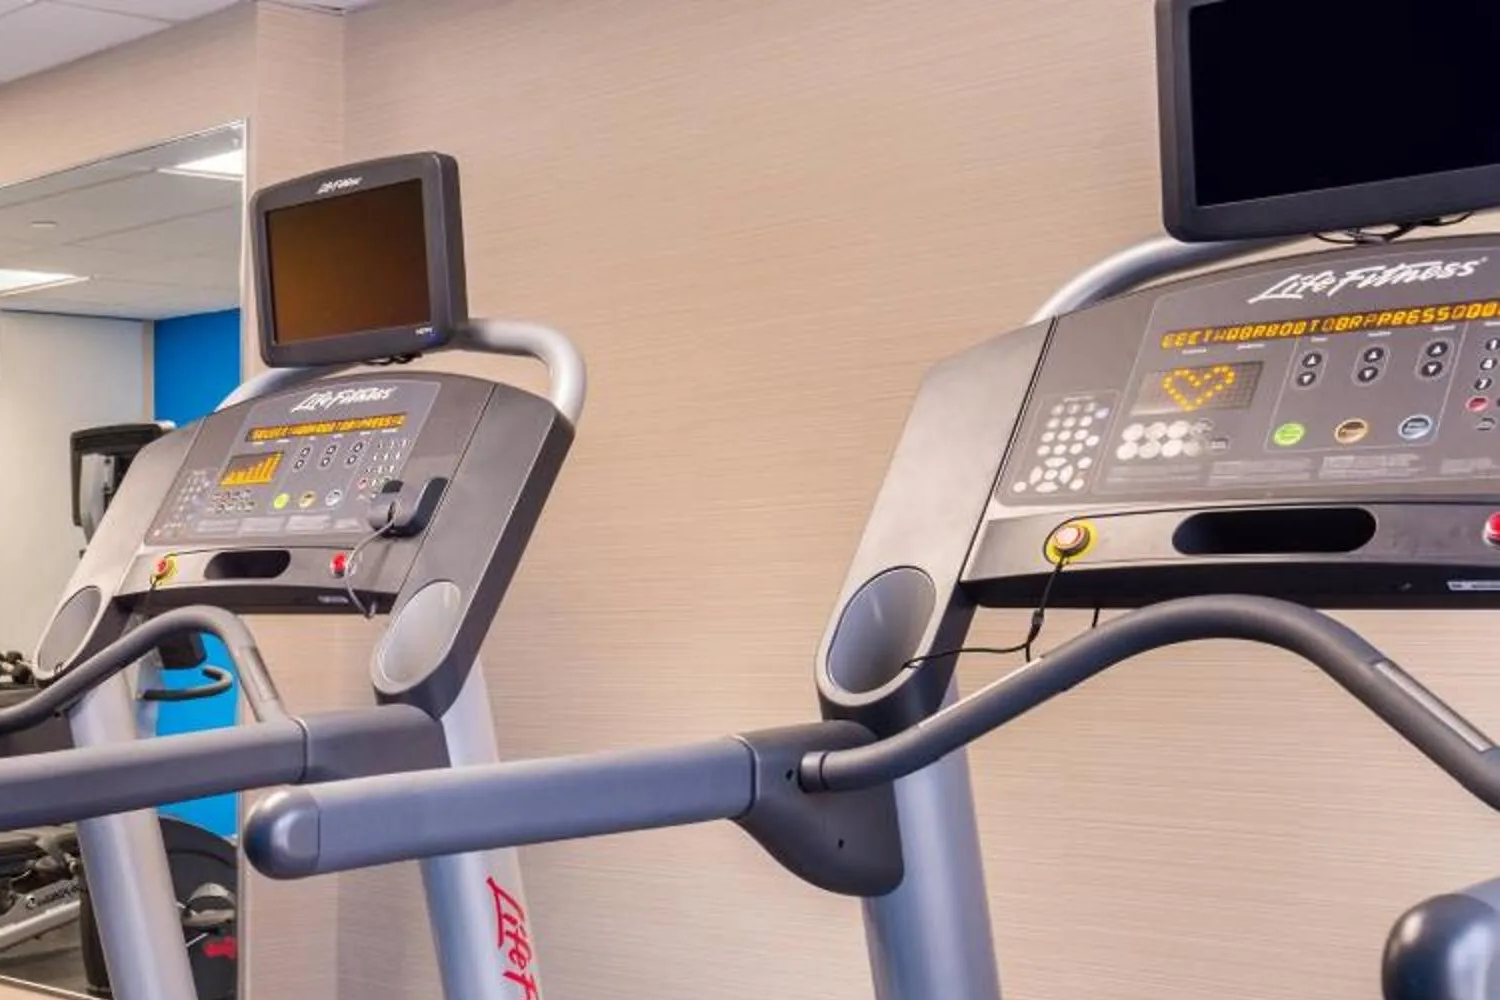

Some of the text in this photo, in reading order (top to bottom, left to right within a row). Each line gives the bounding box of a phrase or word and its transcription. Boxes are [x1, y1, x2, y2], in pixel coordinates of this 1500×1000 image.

[1247, 258, 1480, 304] Life Fitness
[486, 877, 531, 969] Life
